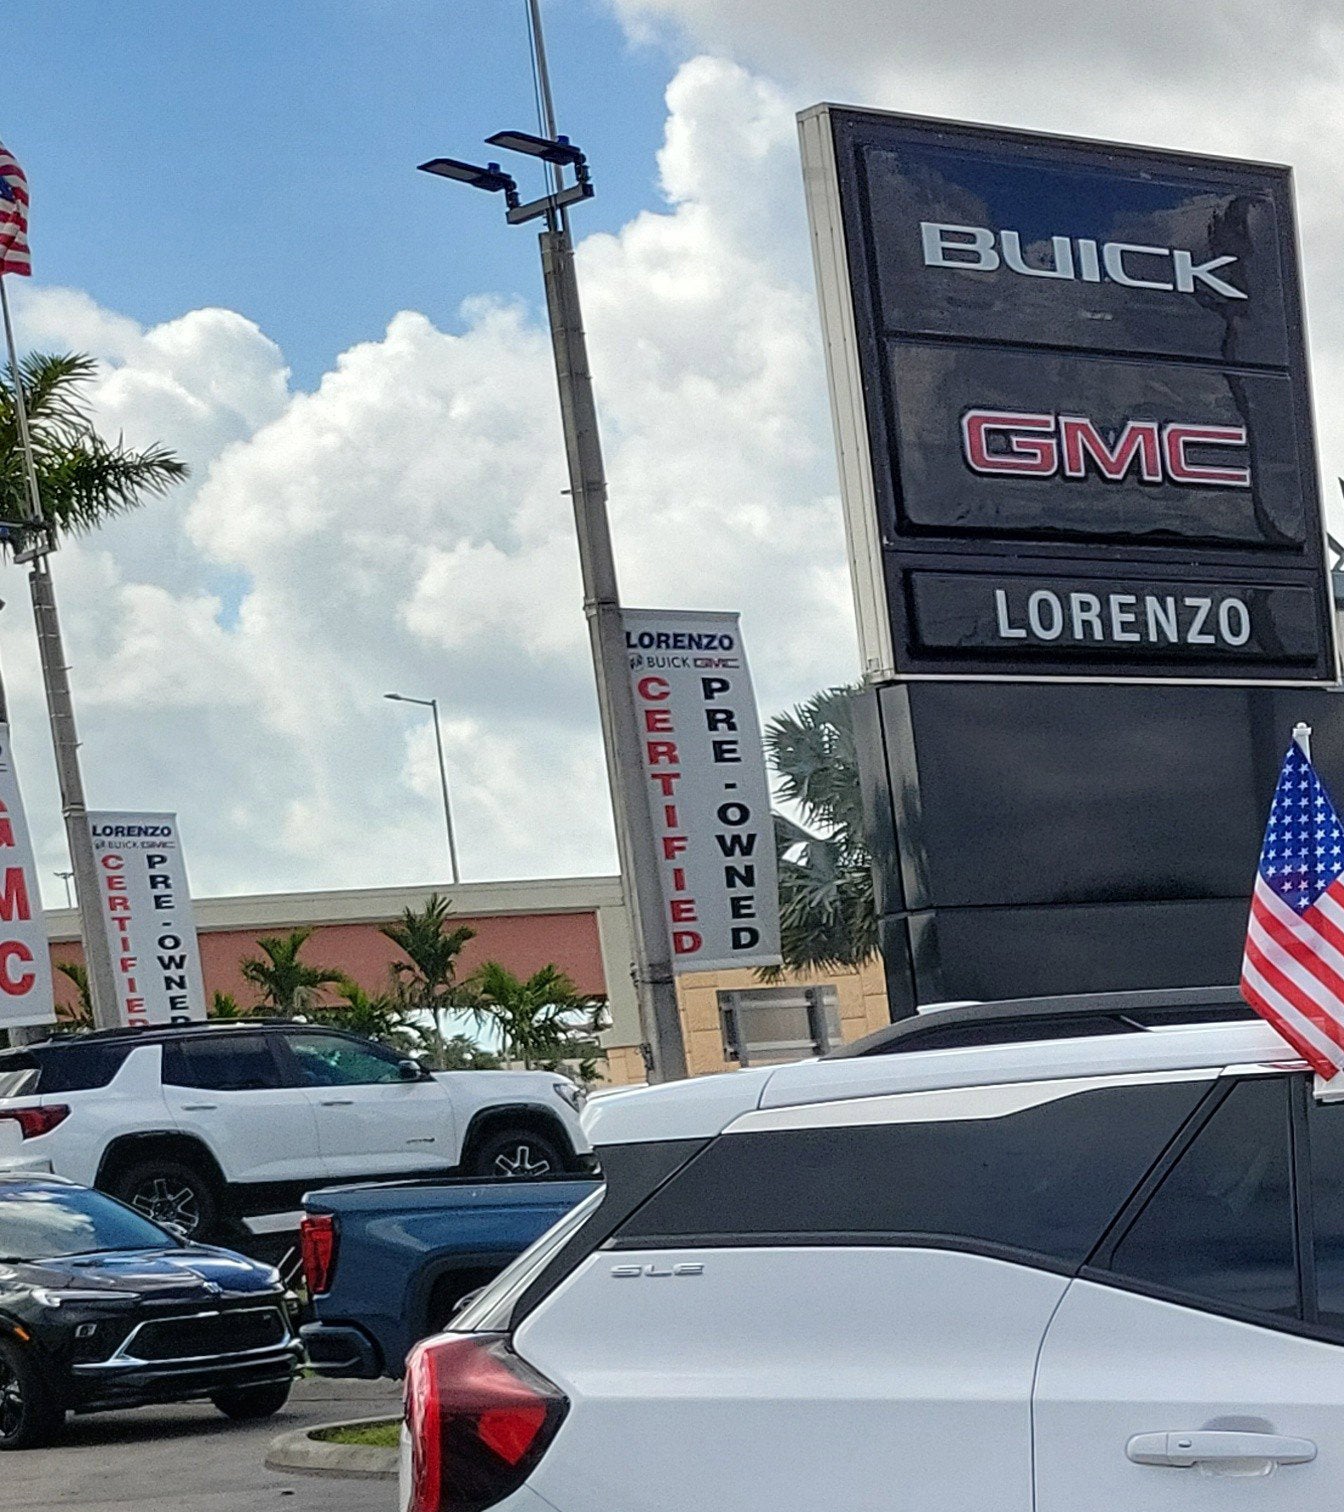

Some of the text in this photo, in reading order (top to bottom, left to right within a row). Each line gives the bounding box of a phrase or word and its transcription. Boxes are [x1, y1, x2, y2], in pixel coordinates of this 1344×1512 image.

[920, 221, 1249, 300] BUICK
[961, 408, 1251, 487] GMC
[625, 631, 735, 651] LORENZO
[994, 589, 1251, 647] LORENZO
[647, 656, 740, 669] BUICK GMC
[92, 825, 172, 838] LORENZO
[637, 676, 703, 955] CERTIFIED
[701, 677, 760, 950] PRE-OWNED
[609, 1262, 706, 1278] SLE
